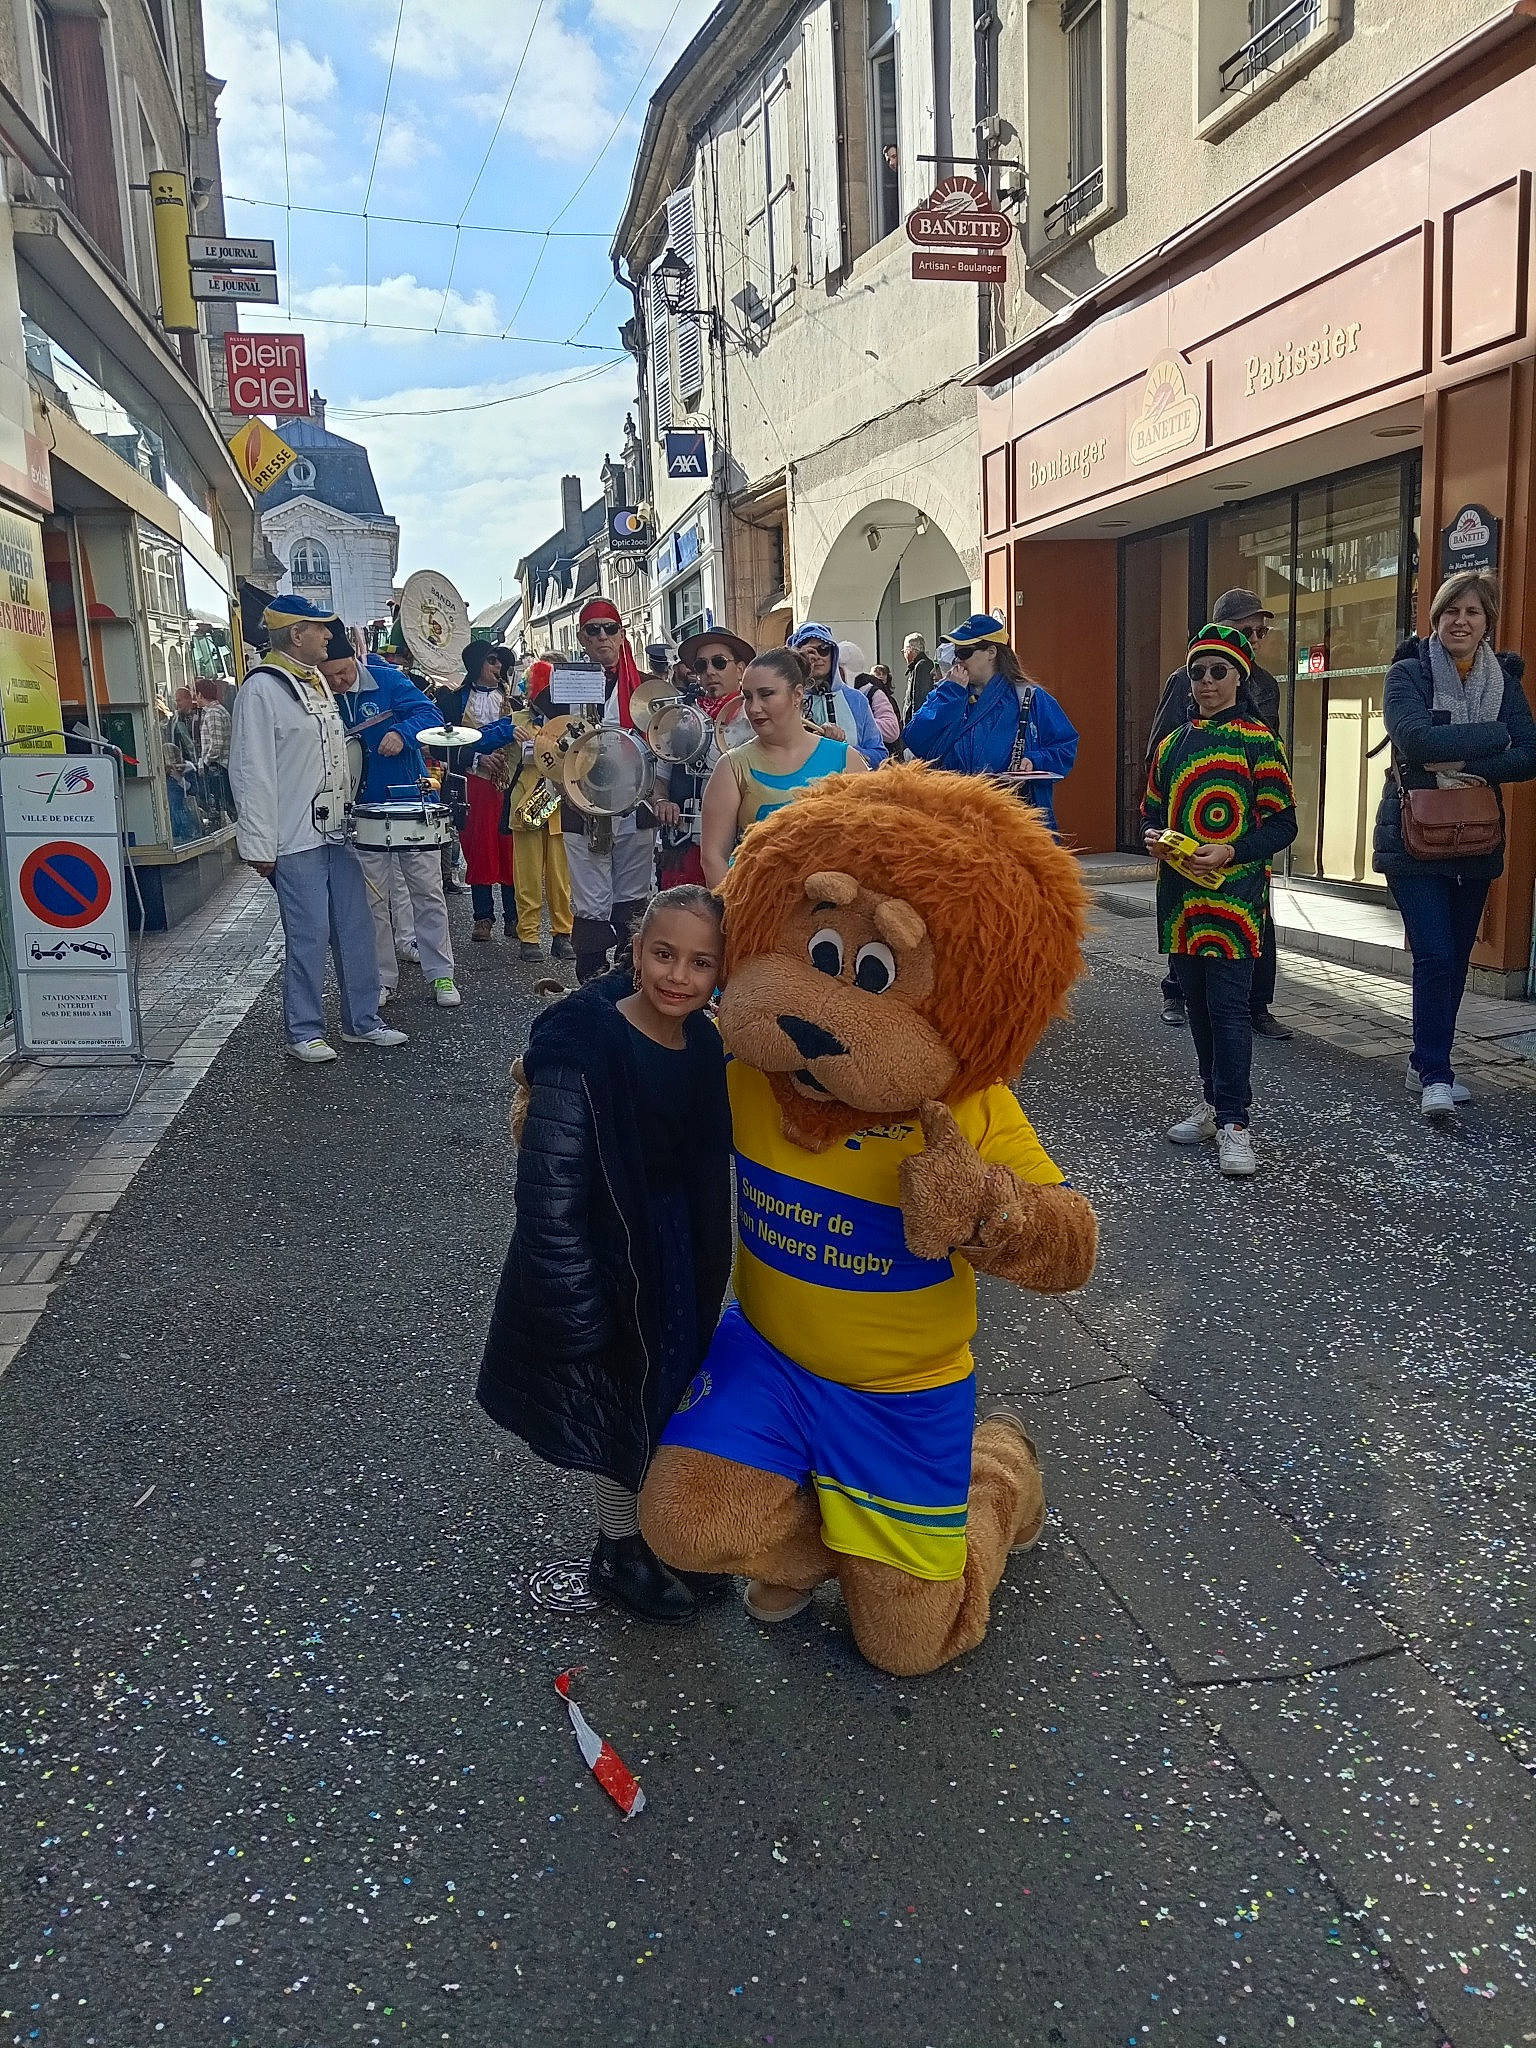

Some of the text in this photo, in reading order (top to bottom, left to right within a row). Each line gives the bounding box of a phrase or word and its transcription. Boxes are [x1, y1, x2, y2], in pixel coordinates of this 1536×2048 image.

[919, 219, 1001, 237] BANETTE
[205, 246, 258, 259] LE JOURNAL
[919, 260, 950, 271] Artisan
[957, 262, 1002, 274] Boulanger
[209, 279, 261, 292] LE JOURNAL
[230, 337, 300, 374] plein
[1244, 321, 1361, 397] Patissier
[234, 367, 304, 409] ciel
[1136, 409, 1191, 450] BANETTE
[254, 449, 292, 487] PRESSE
[668, 455, 702, 473] AXA
[1029, 437, 1107, 490] Boulanger
[0, 515, 33, 552] OURQUOI
[1453, 531, 1485, 544] BANETTE
[9, 575, 31, 606] CHEZ
[431, 587, 456, 611] BANDA
[12, 604, 46, 637] BUTEAU?
[742, 1176, 854, 1237] Supporter de
[757, 1219, 817, 1261] Nevers
[823, 1244, 893, 1276] Rugby
